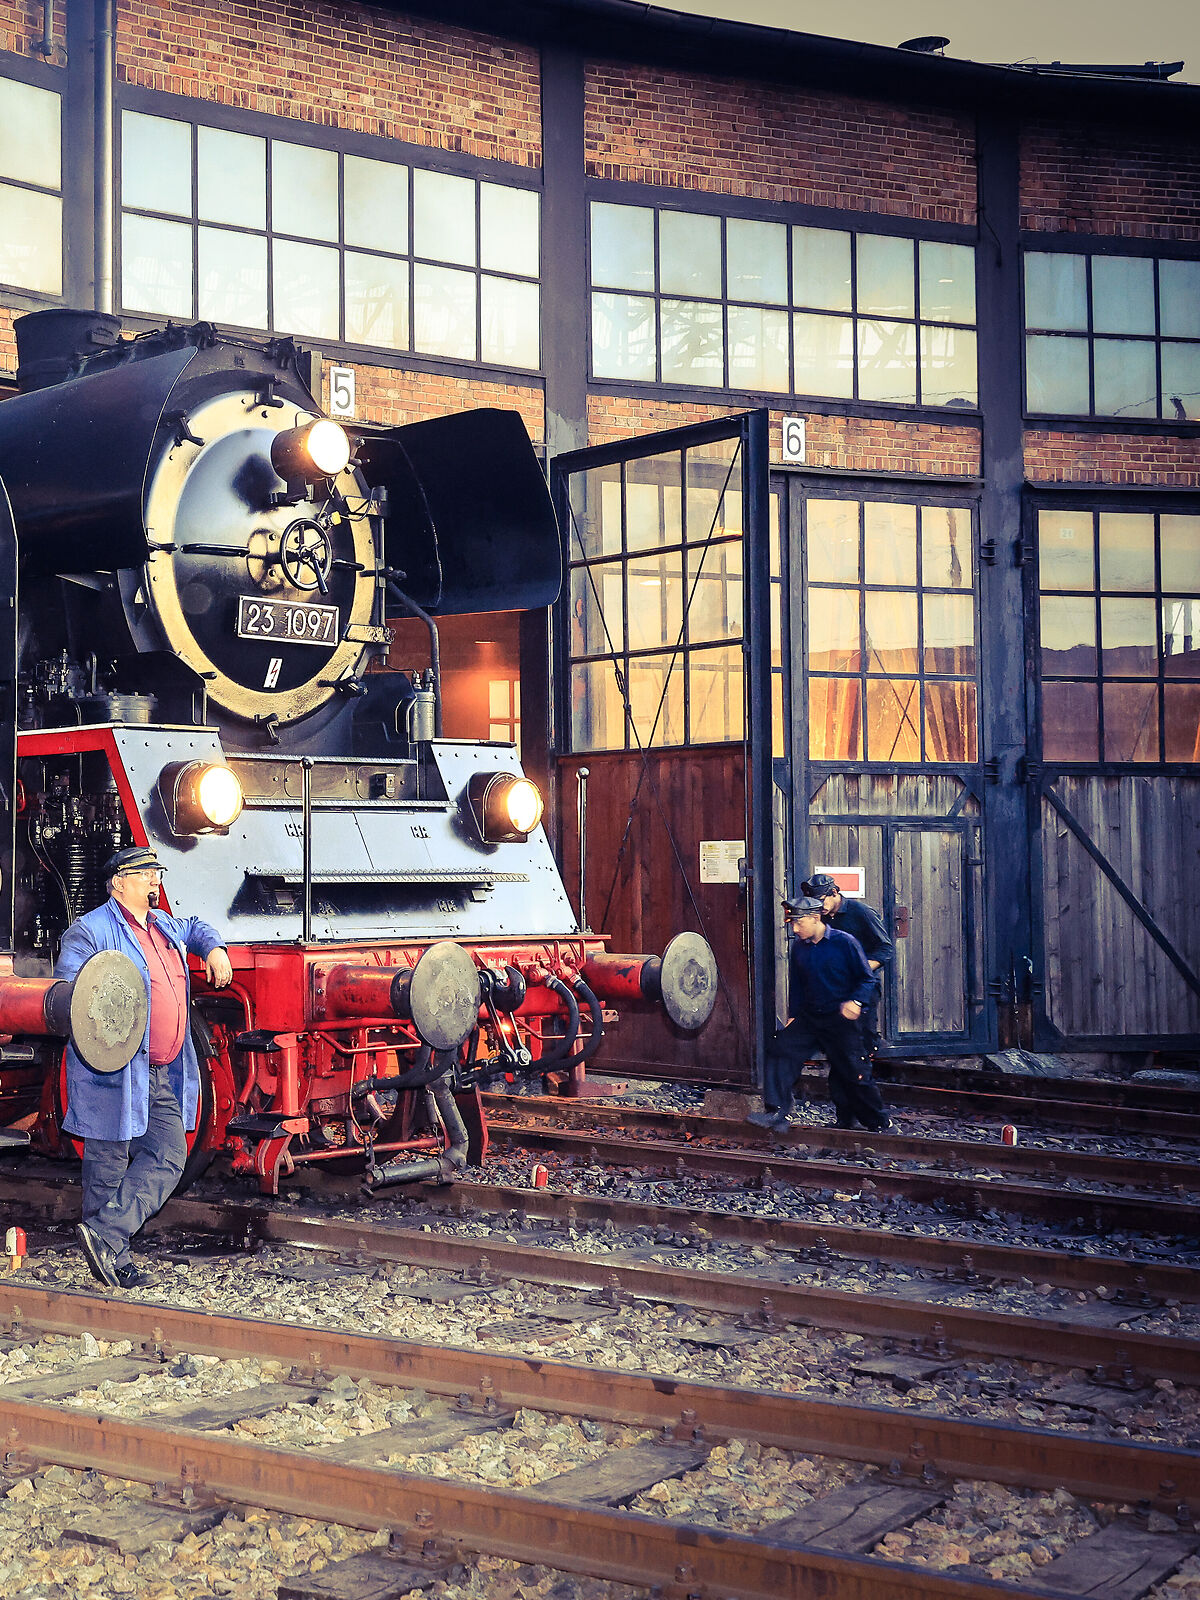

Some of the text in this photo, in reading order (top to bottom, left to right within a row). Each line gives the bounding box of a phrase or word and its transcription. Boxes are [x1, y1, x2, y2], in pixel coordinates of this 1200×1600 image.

[334, 372, 351, 410] 5
[786, 421, 802, 456] 6
[246, 602, 334, 640] 23 1097
